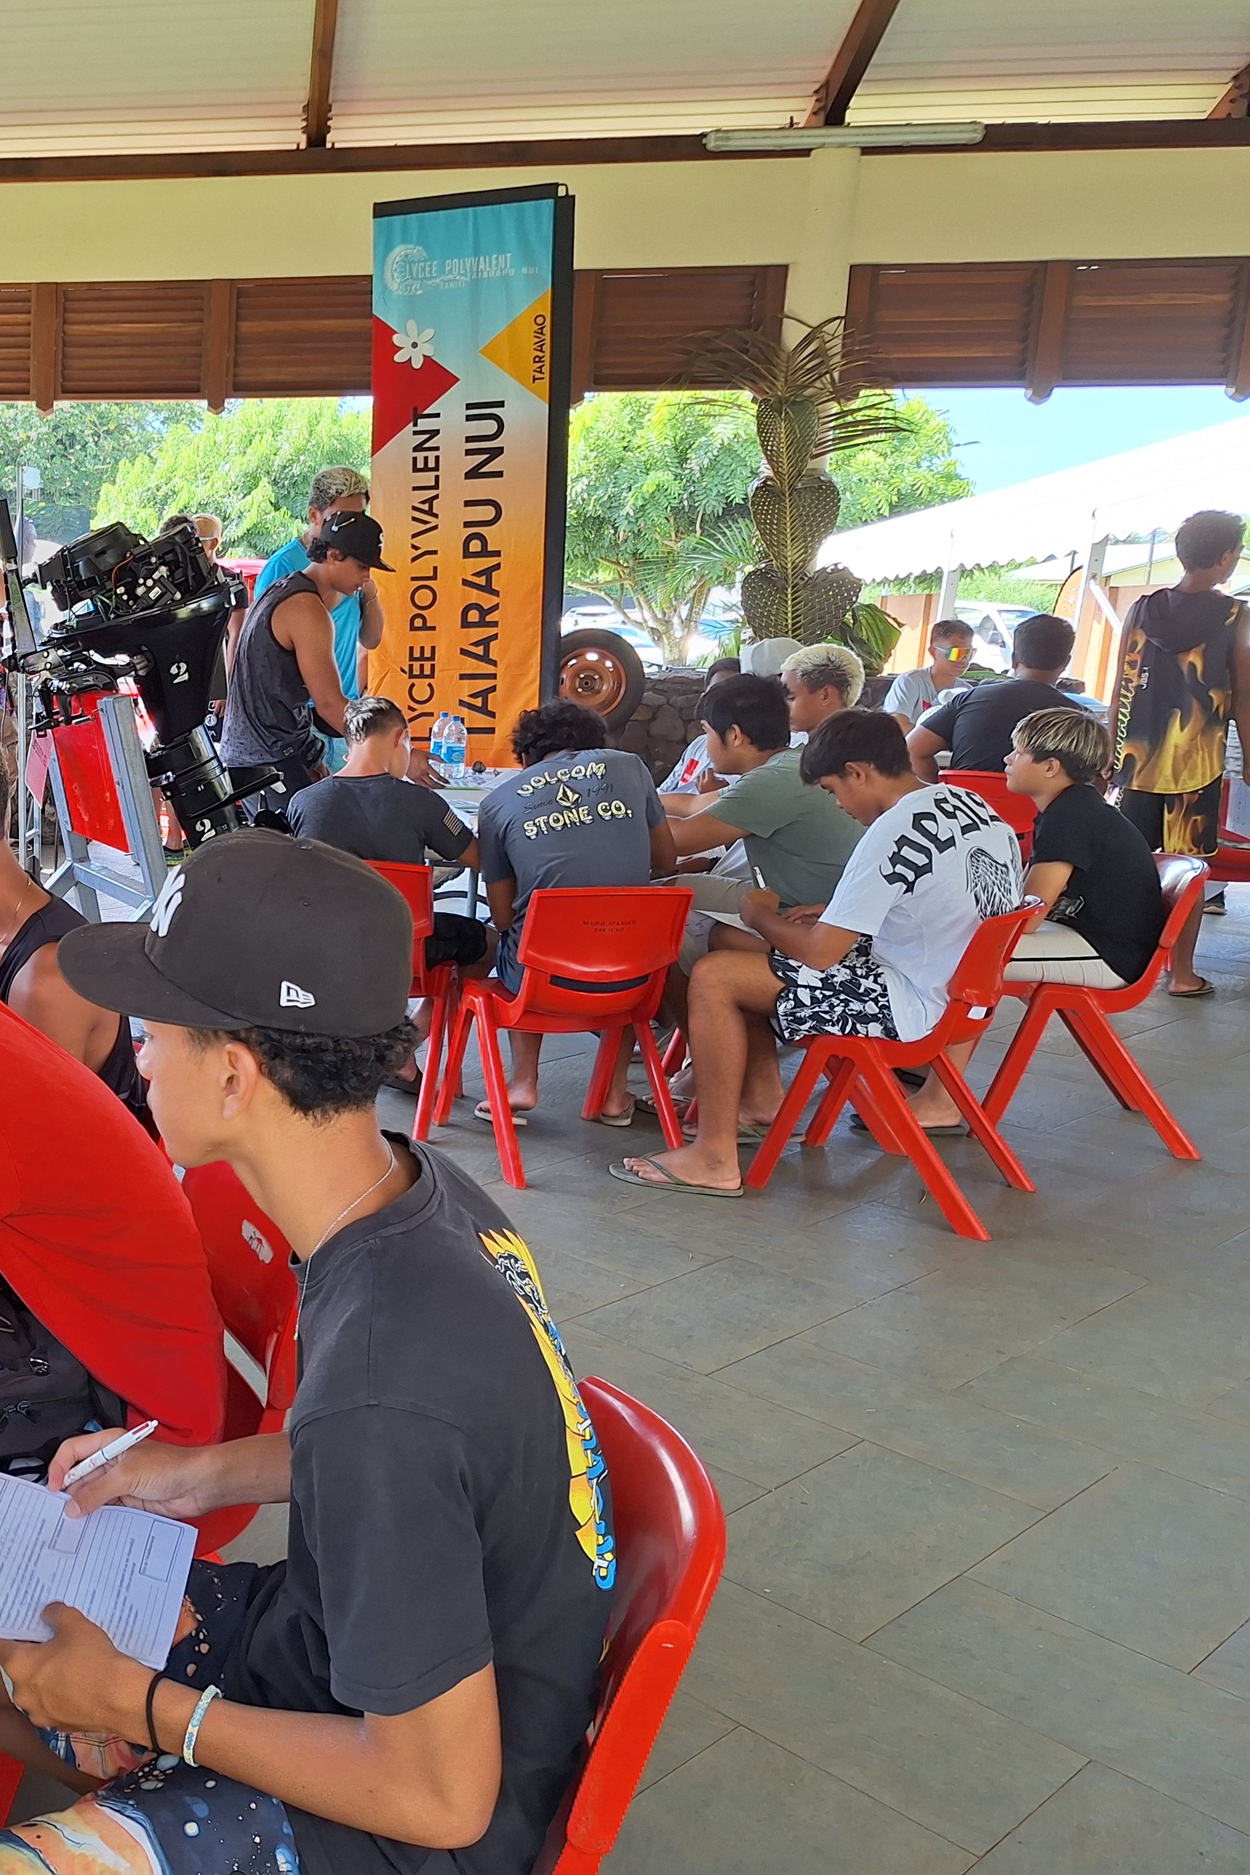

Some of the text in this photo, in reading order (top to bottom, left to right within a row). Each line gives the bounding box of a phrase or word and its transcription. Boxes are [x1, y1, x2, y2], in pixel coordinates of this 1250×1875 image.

[532, 313, 547, 384] TARAVAO
[401, 406, 442, 743] LYCÉE POLYVALENT
[458, 399, 506, 736] TAIARAPU NUI
[169, 661, 190, 684] 2
[195, 817, 217, 842] 2
[523, 805, 593, 841] STONE
